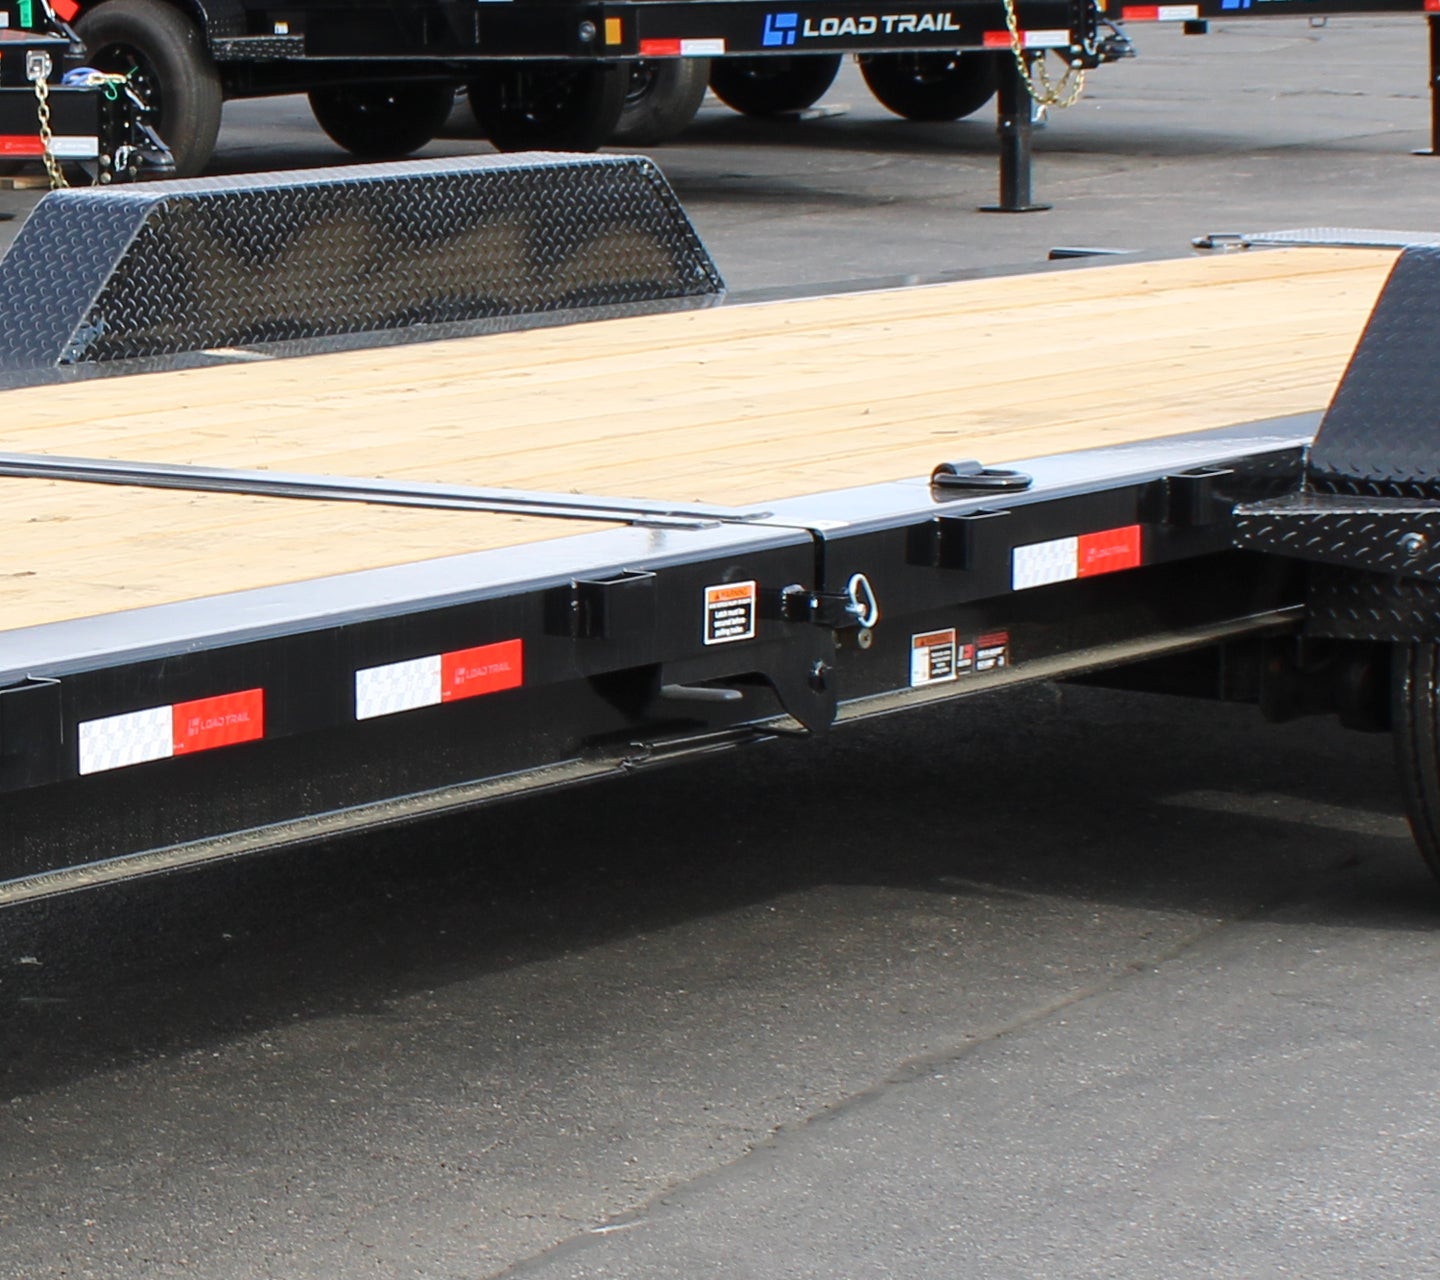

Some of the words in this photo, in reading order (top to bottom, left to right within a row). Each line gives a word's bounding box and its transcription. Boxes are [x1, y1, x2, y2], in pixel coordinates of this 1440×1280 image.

[802, 16, 878, 38] LOAD
[881, 12, 961, 34] TRAIL
[200, 716, 225, 730] LOAD
[225, 711, 251, 725] TRAIL
